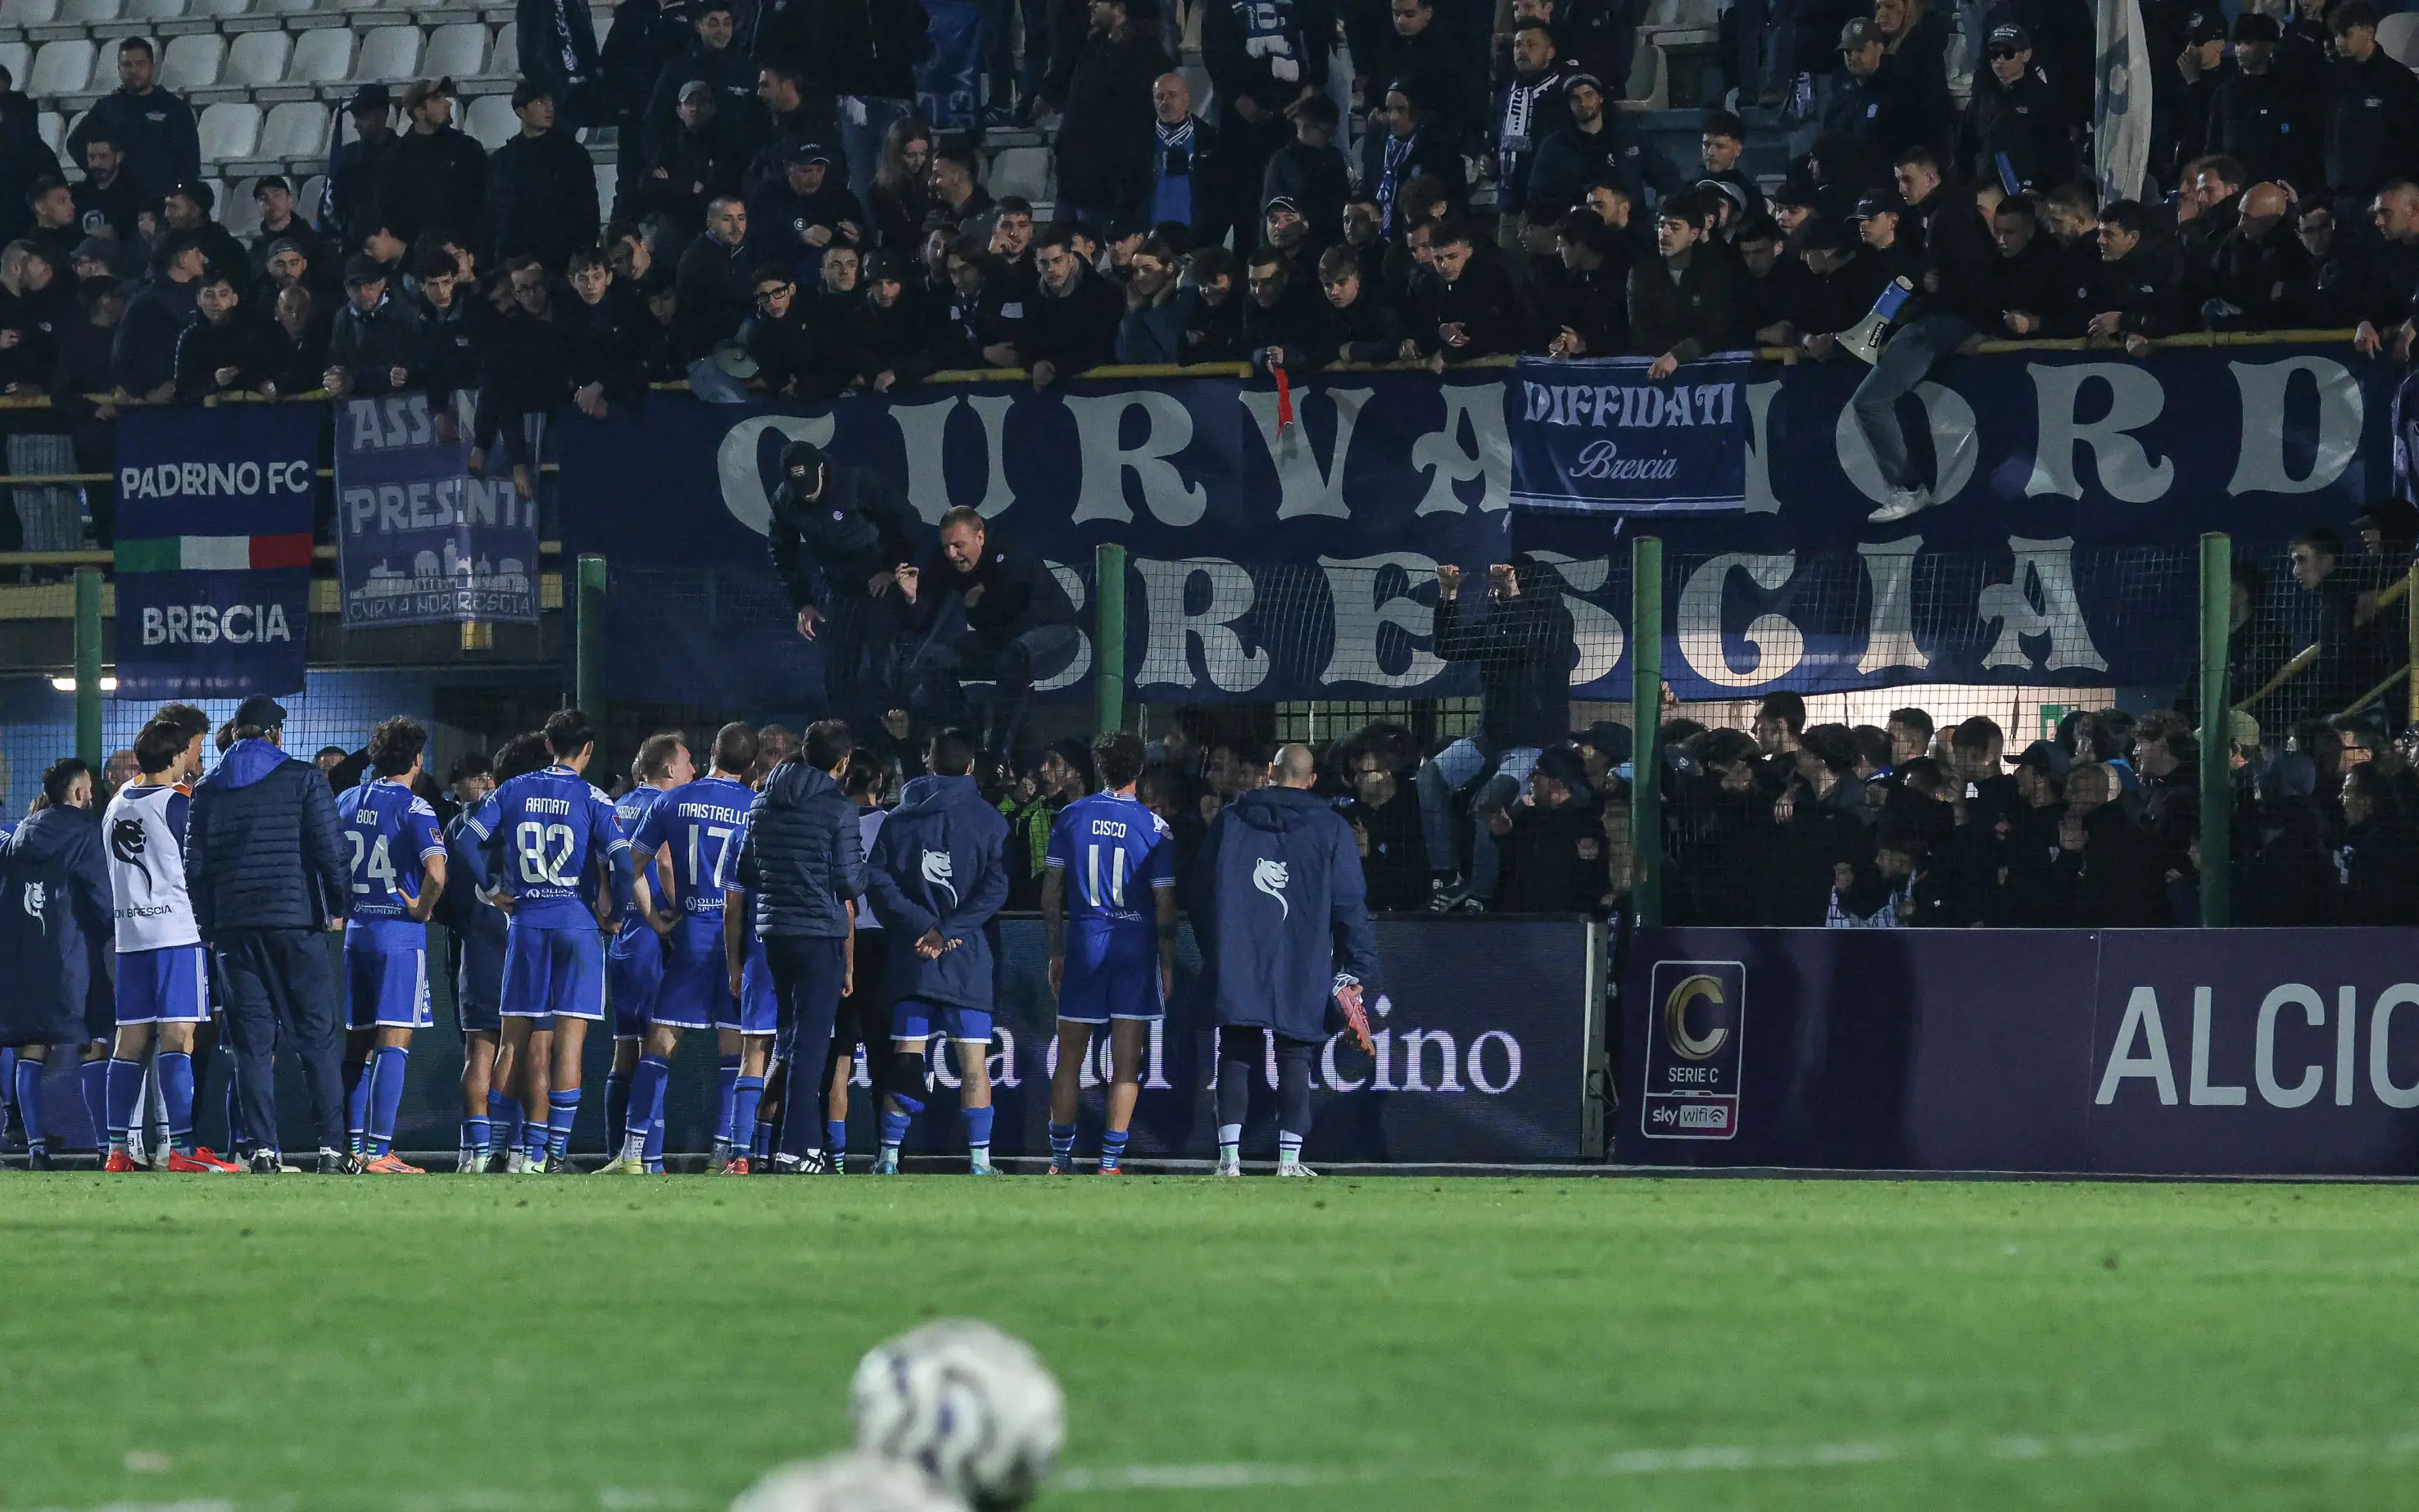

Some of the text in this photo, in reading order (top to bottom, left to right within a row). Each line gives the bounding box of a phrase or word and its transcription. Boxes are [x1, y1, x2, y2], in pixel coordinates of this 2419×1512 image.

[1869, 324, 1884, 346] Brescia
[1523, 380, 1735, 427] DIFFIDATI
[717, 355, 2363, 542] CURVA ORD
[1569, 440, 1678, 480] Brescia
[121, 460, 309, 499] PADERNO FC
[457, 591, 531, 613] RESCIA
[143, 604, 290, 645] BRESCIA
[356, 808, 378, 826] BOCI
[525, 798, 570, 816] ARMATI
[1092, 820, 1126, 838] CISCO
[344, 831, 396, 894] 24
[517, 822, 579, 886] 82
[689, 824, 733, 887] 17
[1089, 844, 1125, 908] 11
[127, 904, 173, 918] BRESCIA
[2094, 982, 2419, 1109] ALCIO
[1668, 1067, 1719, 1083] SERIE C
[1652, 1106, 1708, 1125] sky wifi
